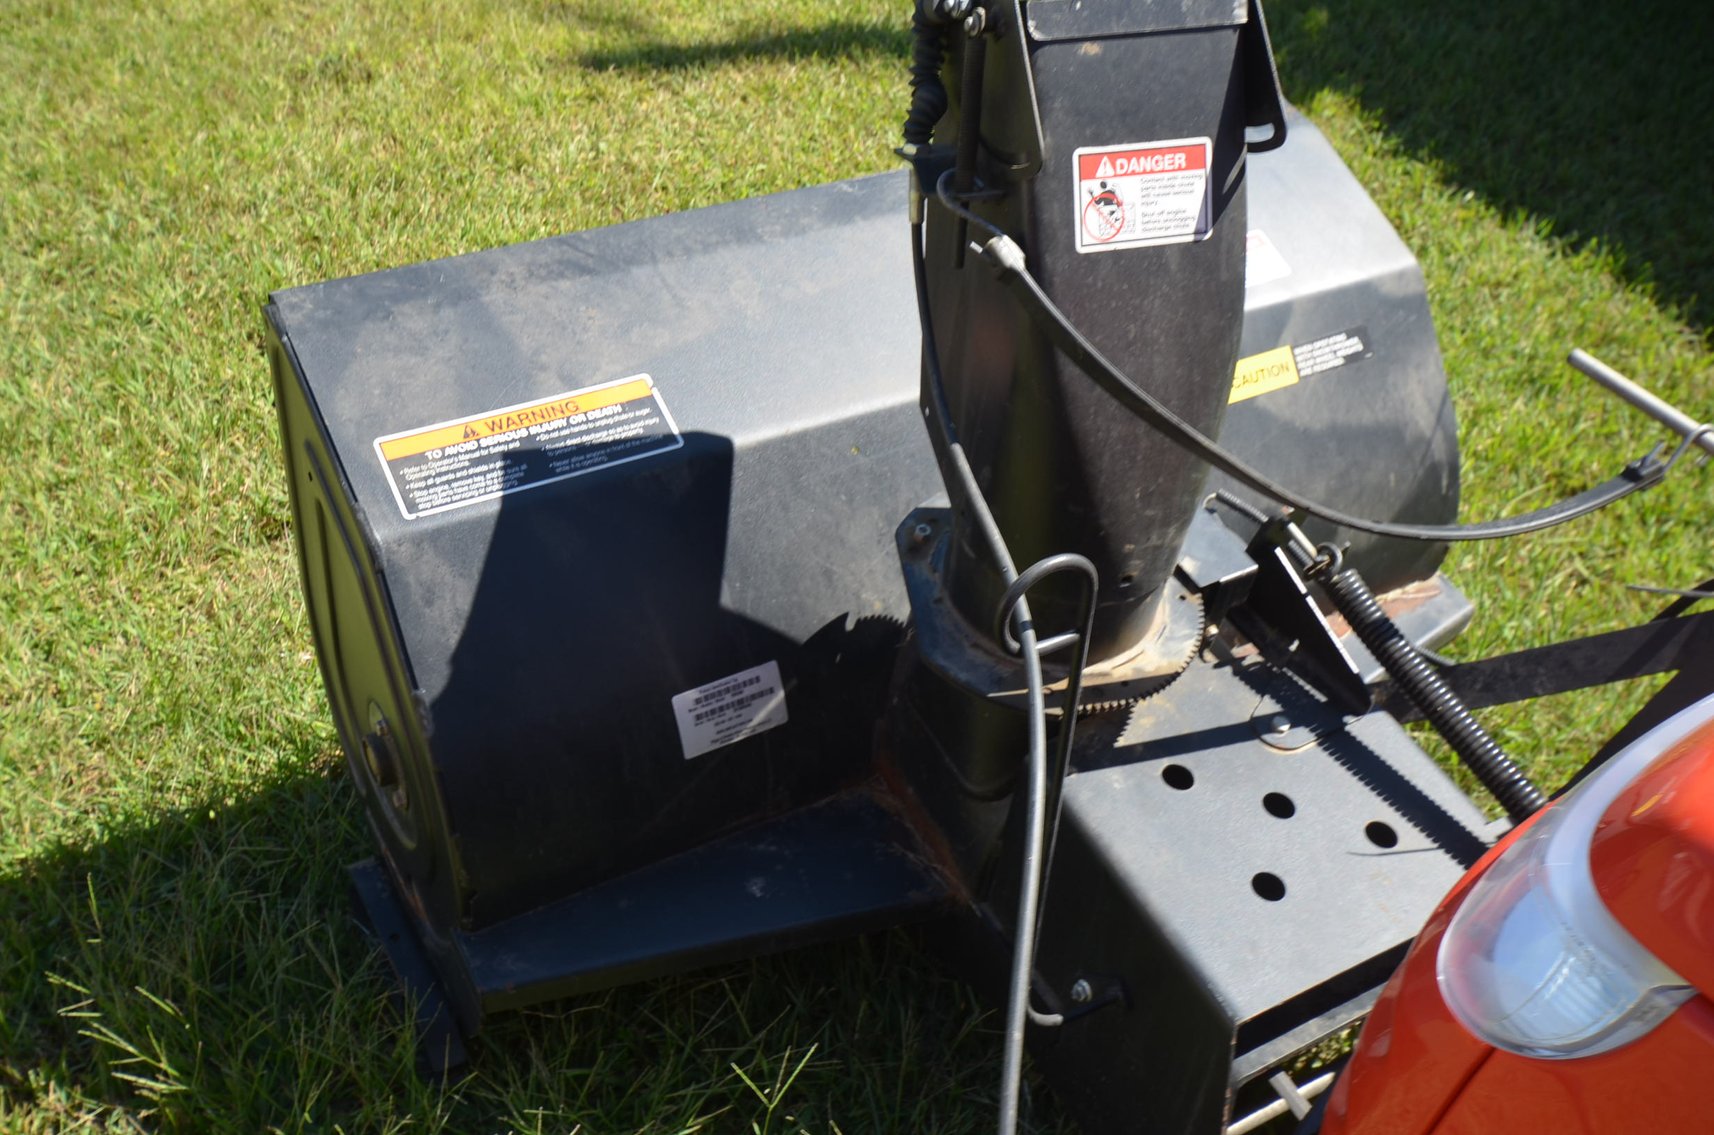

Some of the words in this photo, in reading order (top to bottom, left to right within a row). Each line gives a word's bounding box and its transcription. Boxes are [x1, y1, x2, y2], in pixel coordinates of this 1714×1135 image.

[1116, 152, 1186, 174] DANGER
[1233, 361, 1290, 389] CAUTION
[484, 399, 580, 433] WARNING
[425, 448, 443, 461] TO
[443, 439, 479, 456] AVOID
[479, 426, 528, 447] SERIOUS
[528, 416, 569, 435] INJURY
[568, 412, 586, 425] OR
[586, 403, 622, 420] DEATH
